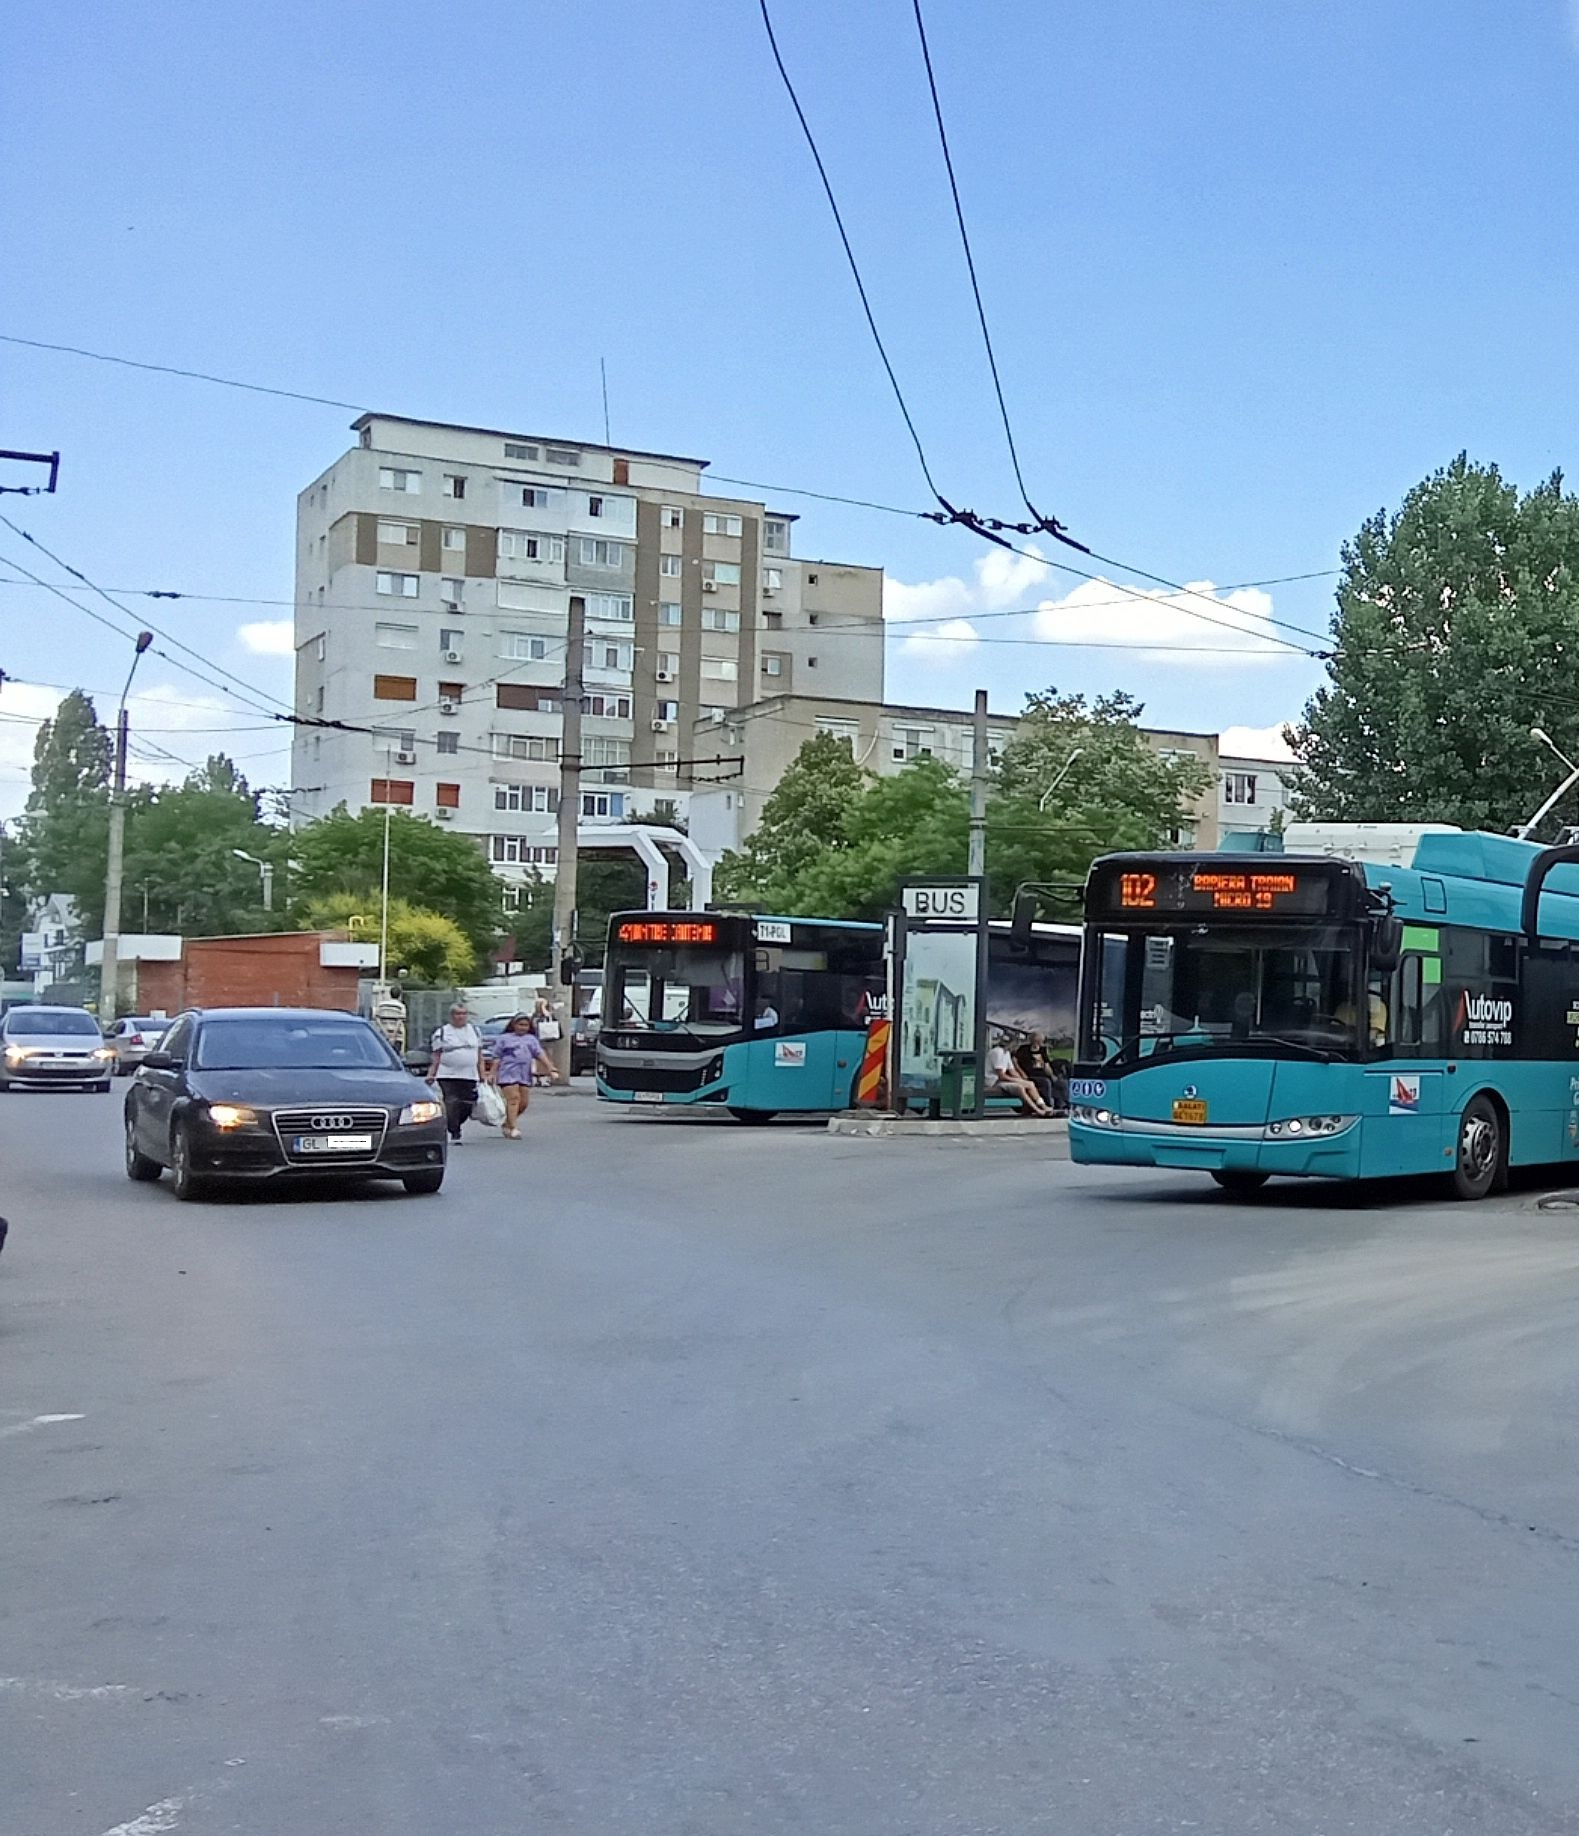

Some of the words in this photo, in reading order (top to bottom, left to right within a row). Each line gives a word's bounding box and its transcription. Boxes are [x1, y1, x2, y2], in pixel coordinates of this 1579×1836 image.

[1120, 873, 1156, 907] 102
[915, 891, 966, 914] BUS
[302, 1138, 320, 1149] GL
